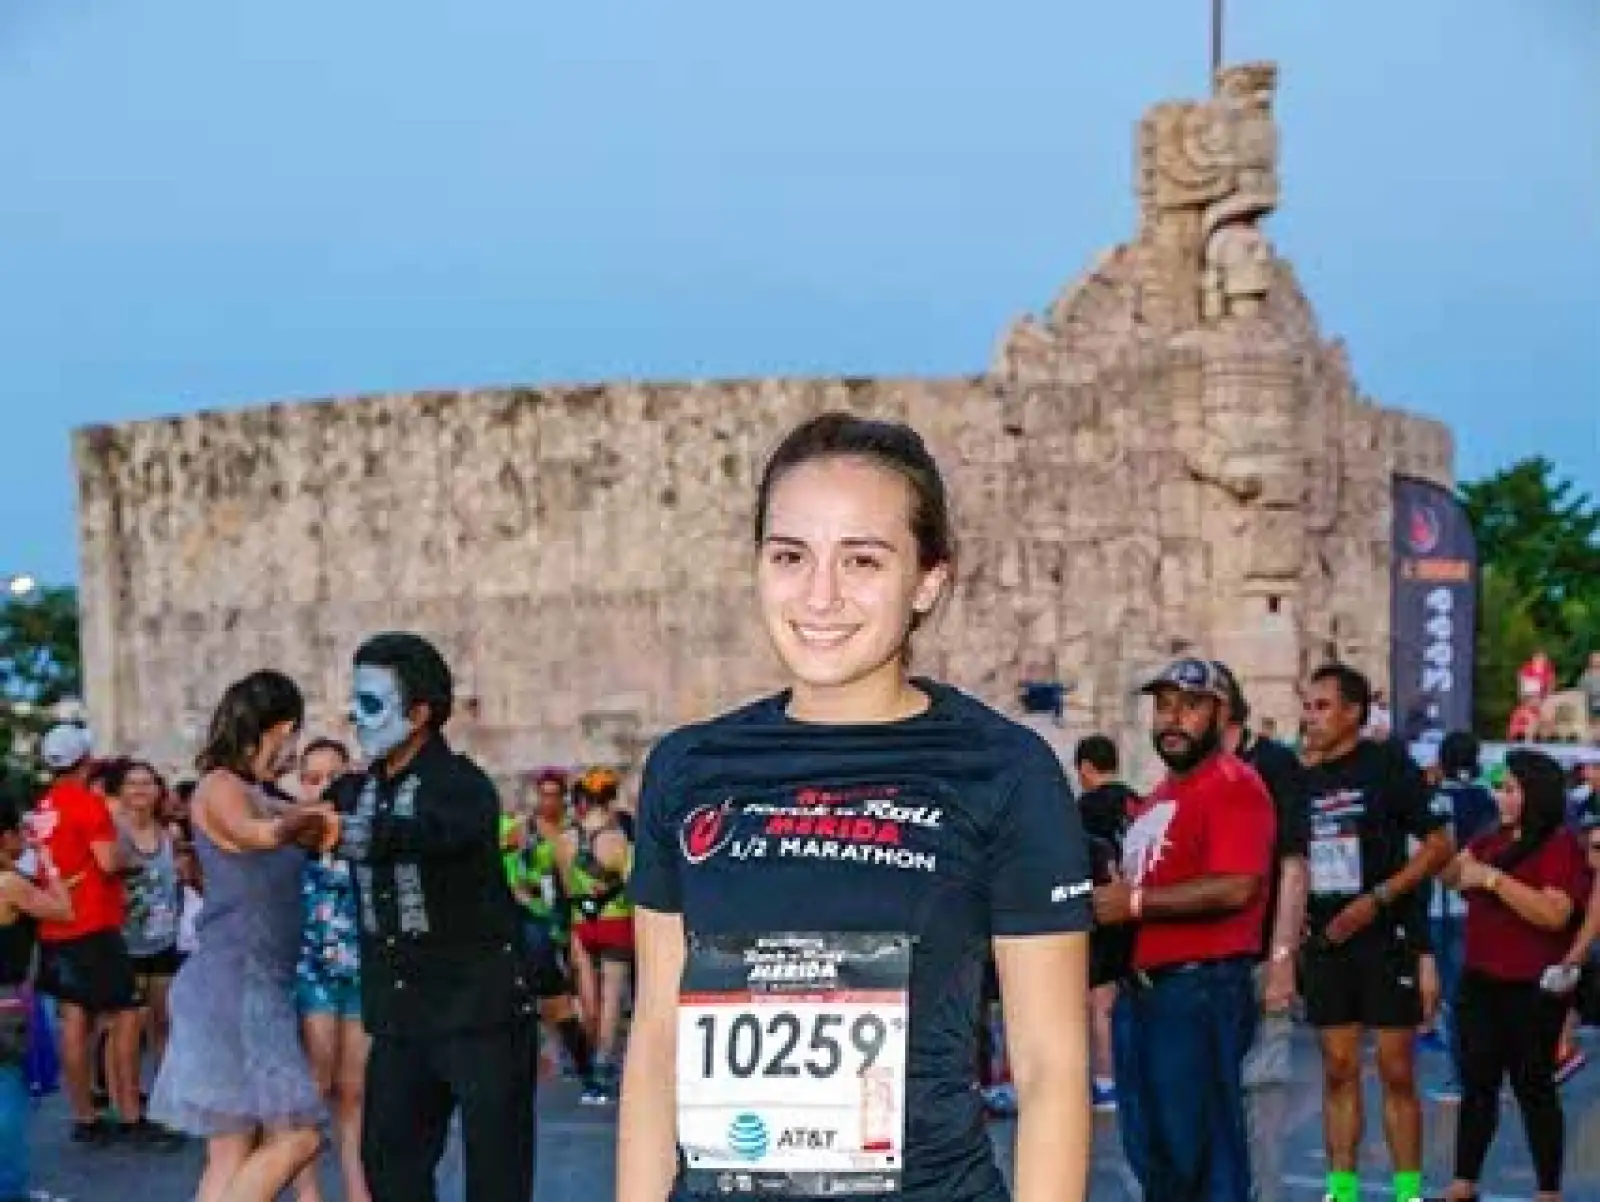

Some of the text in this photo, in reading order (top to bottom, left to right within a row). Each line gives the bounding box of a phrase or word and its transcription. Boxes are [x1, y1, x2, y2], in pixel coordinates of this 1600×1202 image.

[729, 837, 936, 872] 1/2 MARATHON
[695, 1013, 887, 1079] 10259
[777, 1127, 838, 1150] AT&T
